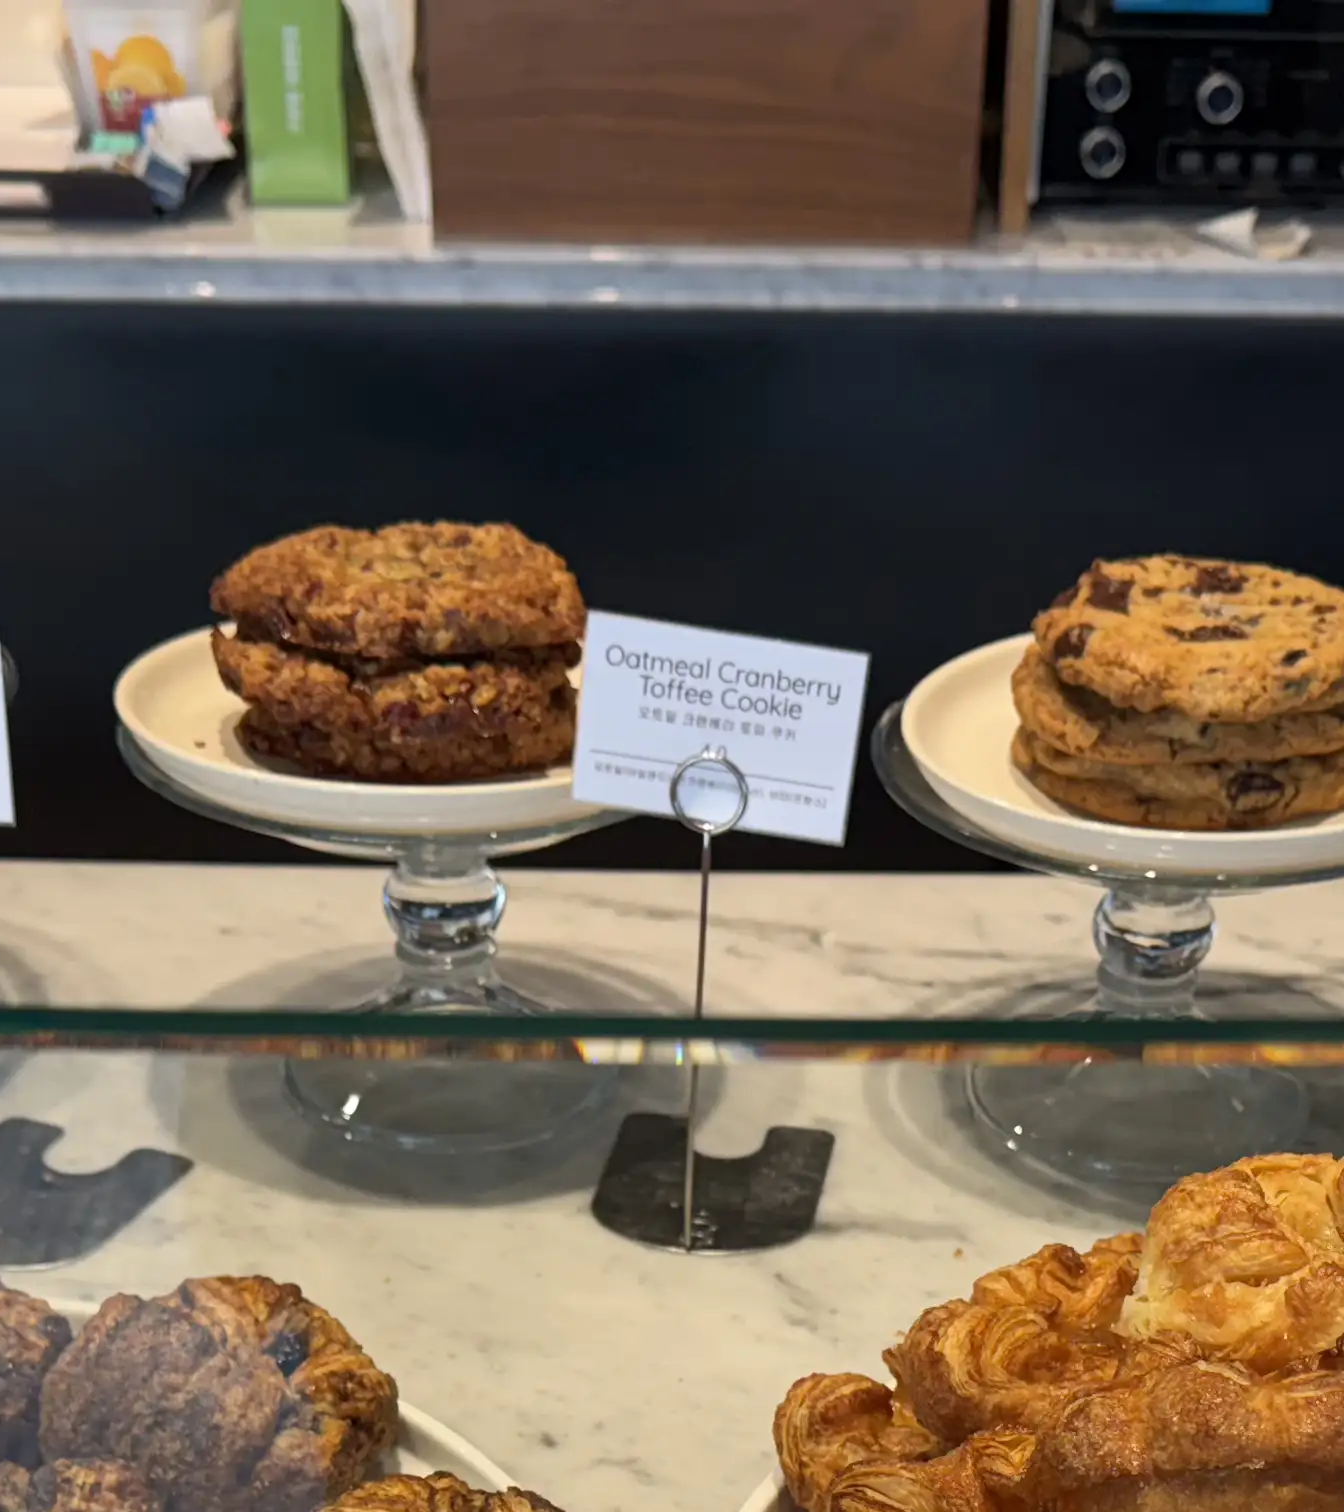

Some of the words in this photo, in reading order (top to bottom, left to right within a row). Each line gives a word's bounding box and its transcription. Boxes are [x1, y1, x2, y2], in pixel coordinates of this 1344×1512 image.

[605, 644, 711, 680] Oatmeal
[718, 662, 842, 705] Cranberry
[639, 675, 713, 706] Toffee
[721, 687, 803, 720] Cookie
